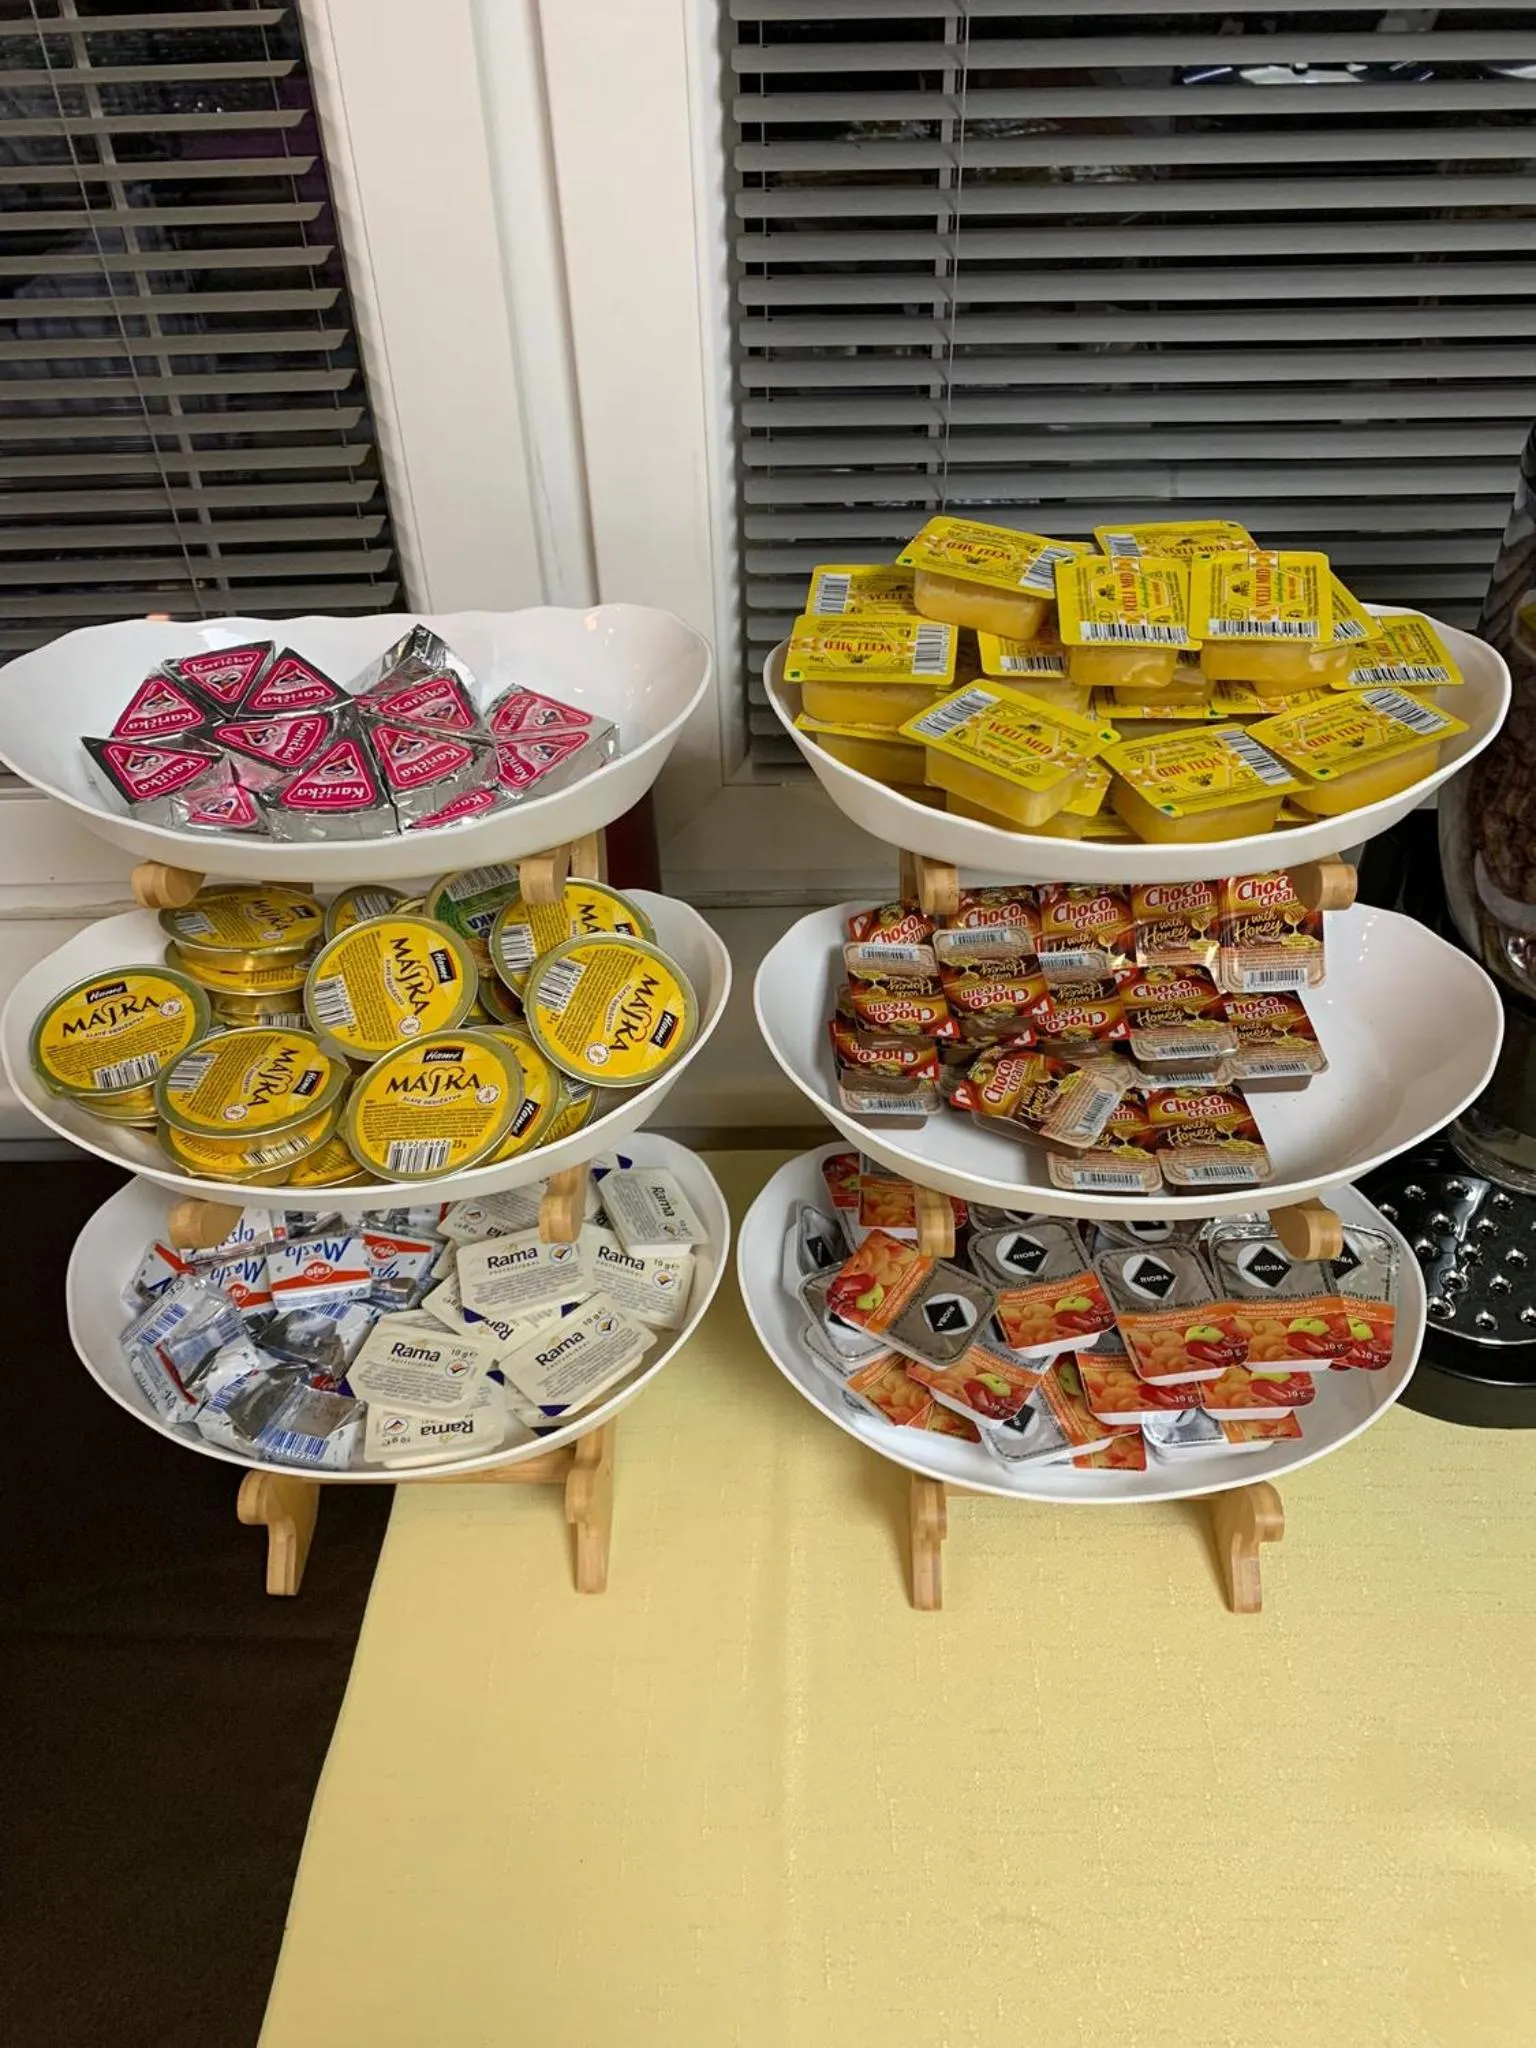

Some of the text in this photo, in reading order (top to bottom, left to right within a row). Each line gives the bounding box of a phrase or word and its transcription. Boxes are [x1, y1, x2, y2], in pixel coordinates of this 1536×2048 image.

[191, 654, 254, 673] Karička
[261, 688, 328, 704] Karička
[390, 685, 448, 713] Karička
[127, 712, 195, 730] Karička
[281, 720, 316, 760] Karička
[400, 748, 460, 778] Karička
[136, 758, 198, 791] Karička
[296, 784, 367, 799] Karička
[1144, 882, 1204, 906] Choco
[1167, 892, 1212, 912] cream
[1260, 889, 1296, 908] crea
[965, 904, 1021, 928] Choco
[1053, 897, 1111, 923] Choco
[1074, 909, 1118, 929] cream
[1252, 911, 1277, 923] with
[1144, 924, 1190, 944] Honey
[1235, 919, 1283, 941] Honey
[390, 937, 435, 1016] MÁJKA
[962, 984, 1005, 998] cream
[970, 988, 1029, 1009] Choco
[1132, 980, 1191, 998] Choco
[1157, 987, 1201, 1001] cream
[62, 995, 160, 1038] MÁJKA
[609, 973, 660, 1051] MÁJKA
[868, 1001, 911, 1013] cream
[875, 1008, 936, 1023] Choco
[1038, 1007, 1083, 1024] cream
[1245, 1006, 1288, 1020] cream
[1046, 1011, 1107, 1032] Choco
[1237, 1027, 1272, 1040] oney
[858, 1049, 920, 1065] Choco
[247, 1046, 301, 1107] MÁJKA
[385, 1066, 481, 1097] MÁJKA
[983, 1060, 1014, 1104] Choco
[1008, 1059, 1027, 1094] cream
[1160, 1095, 1224, 1115] Choco
[1187, 1103, 1234, 1119] cream
[1167, 1127, 1217, 1144] Honey
[286, 1235, 353, 1267] Maslo
[486, 1247, 539, 1270] Rama
[597, 1245, 646, 1271] Rama
[1012, 1249, 1042, 1261] RIOBA
[209, 1257, 268, 1289] Maslo
[1253, 1263, 1285, 1272] RIOBA
[1139, 1273, 1169, 1284] RIOBA
[390, 1341, 442, 1364] Rama
[535, 1331, 587, 1367] Rama
[420, 1419, 474, 1436] Rama
